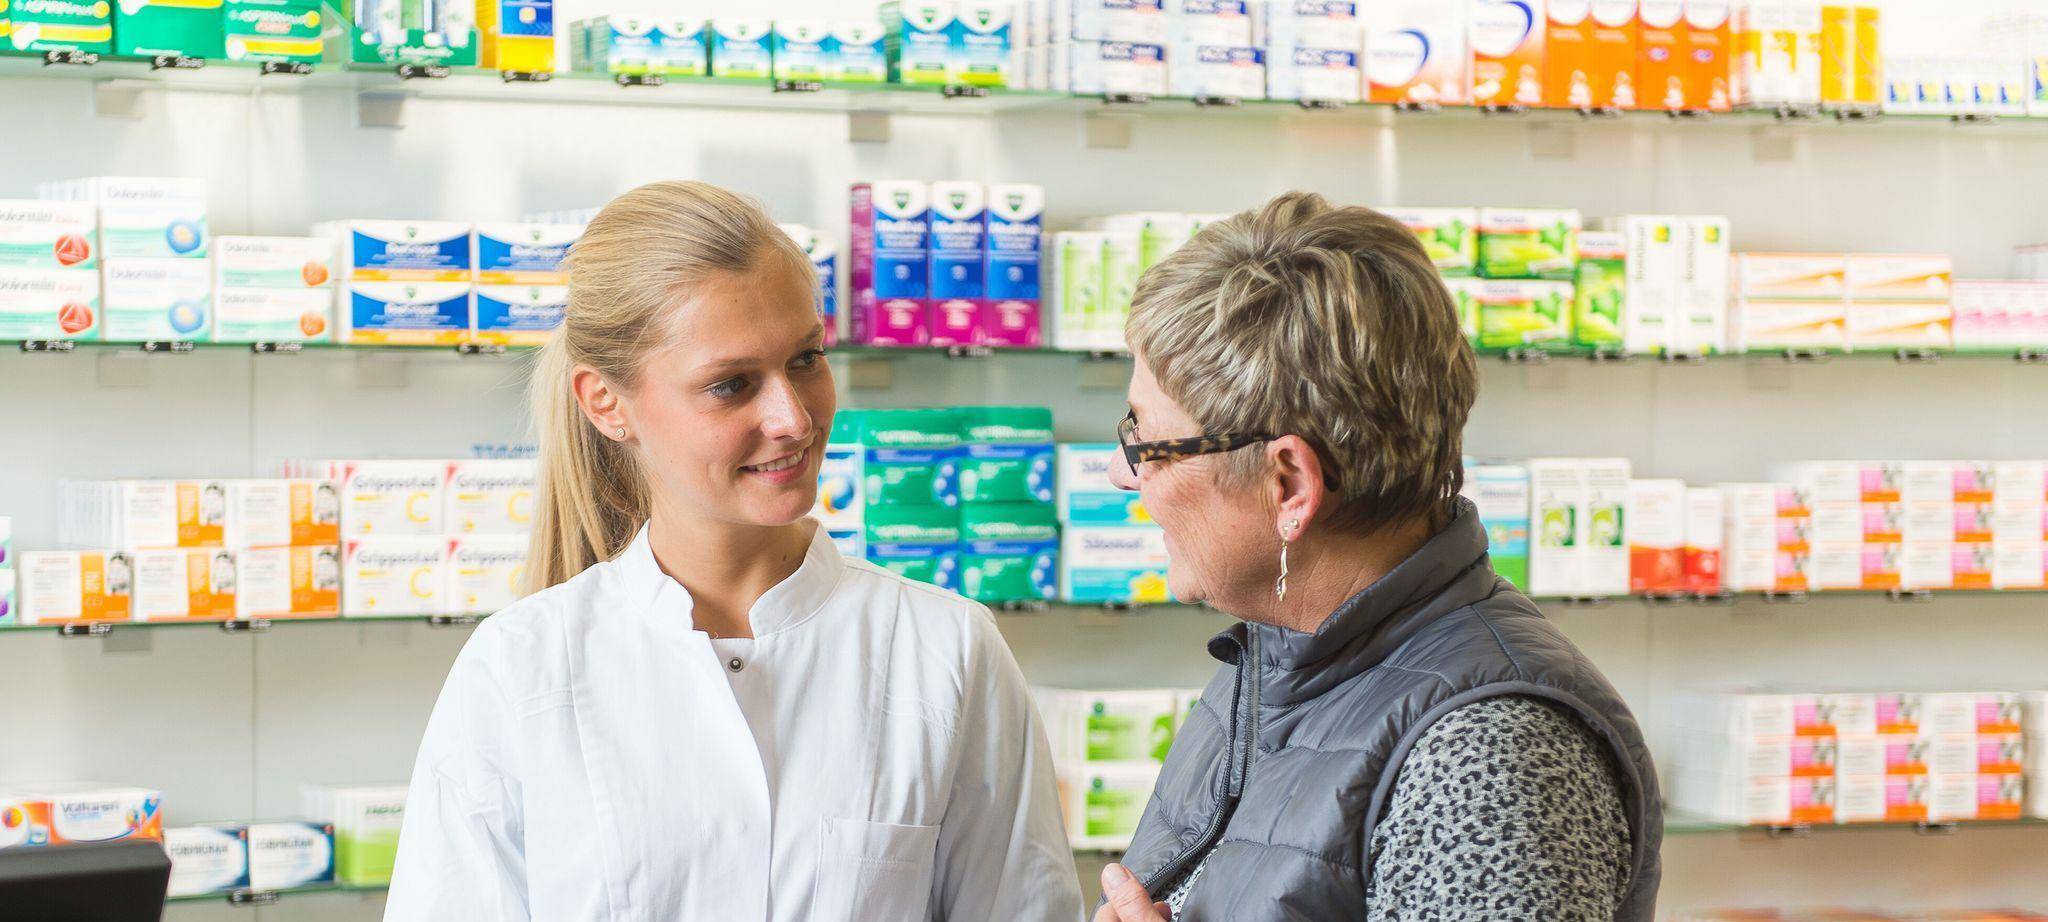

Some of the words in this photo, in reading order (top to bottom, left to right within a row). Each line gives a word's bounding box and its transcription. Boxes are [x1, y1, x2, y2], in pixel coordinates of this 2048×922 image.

[353, 474, 437, 491] Grippostad
[405, 491, 431, 524] C
[507, 491, 531, 524] C
[357, 550, 440, 567] Grippostad
[408, 566, 434, 599] C
